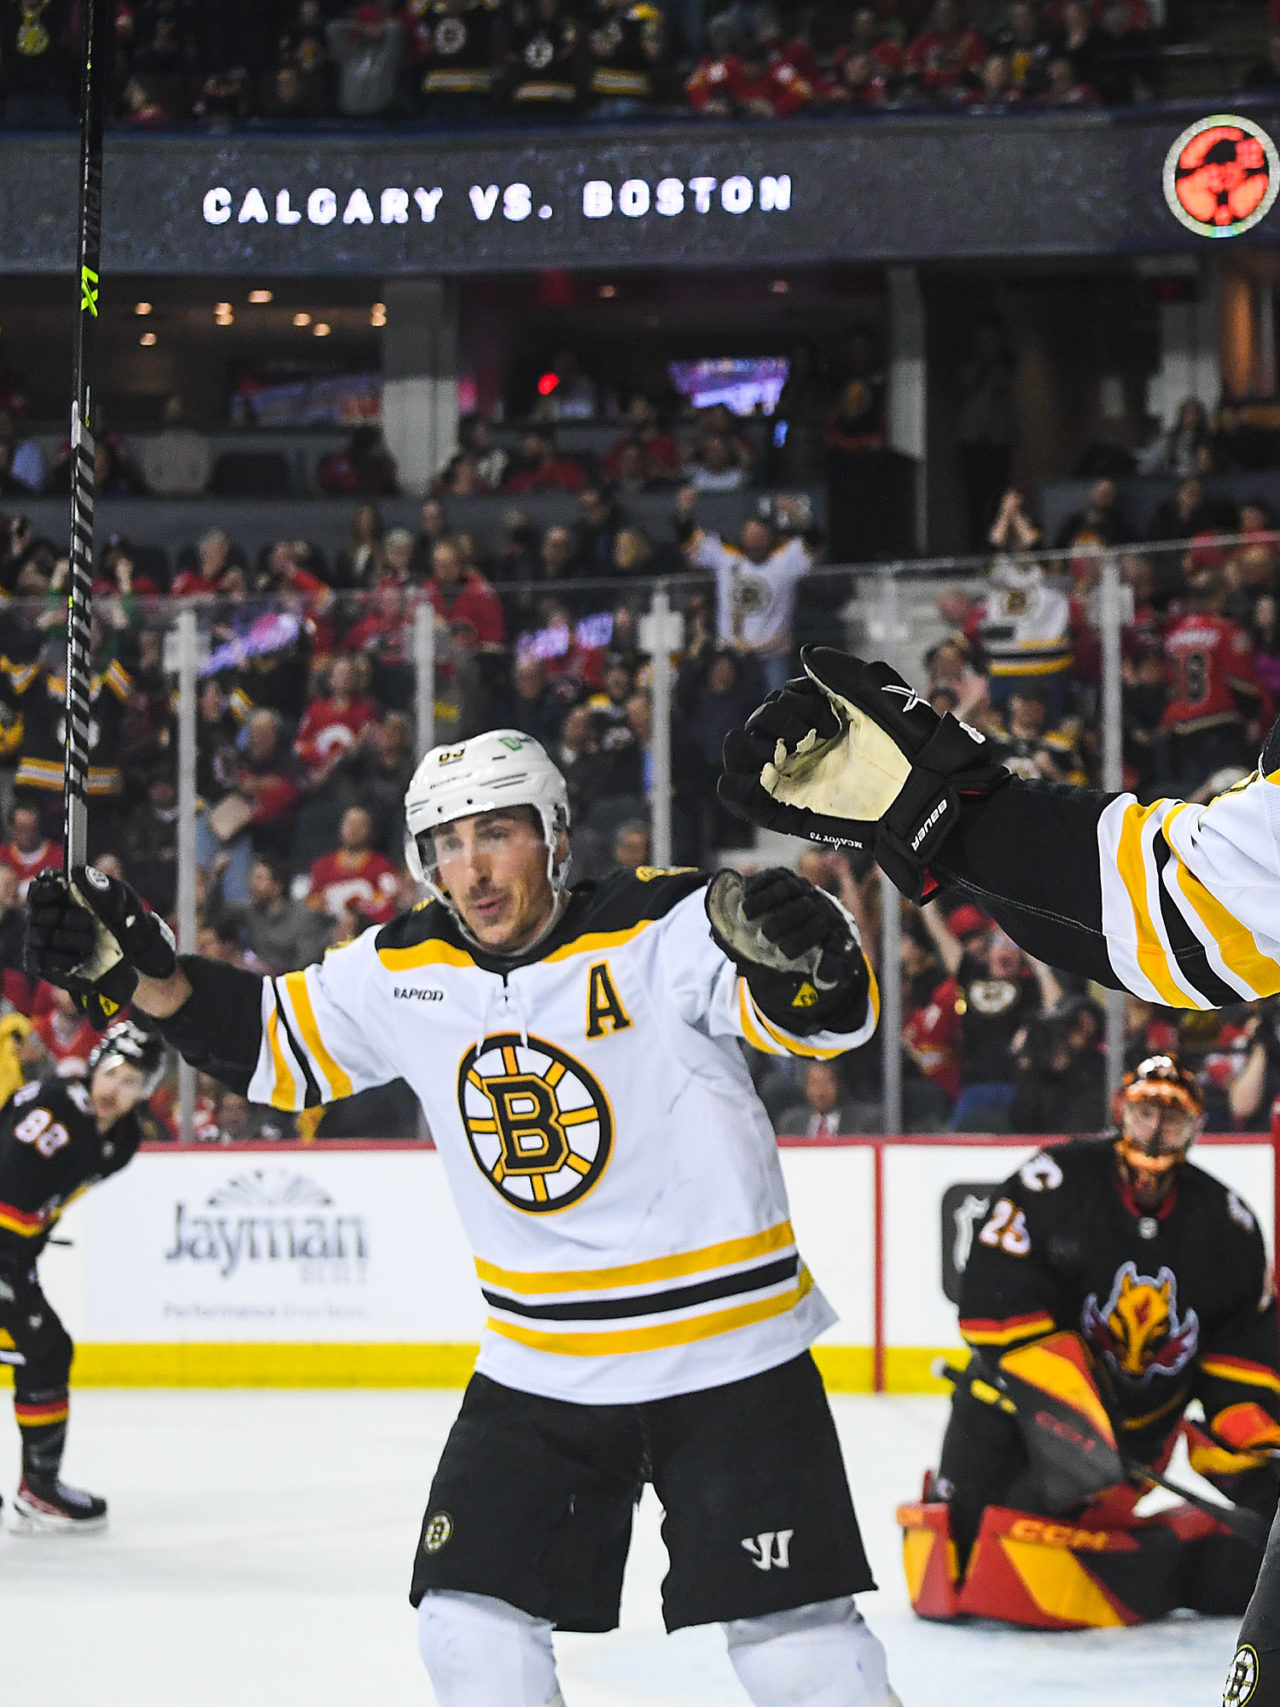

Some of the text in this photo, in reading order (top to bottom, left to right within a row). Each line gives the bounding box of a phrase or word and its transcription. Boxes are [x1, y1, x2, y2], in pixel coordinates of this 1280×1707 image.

[203, 174, 792, 225] CALGARY VS. BOSTON
[911, 799, 947, 851] BAUER
[584, 960, 635, 1041] A
[14, 1107, 70, 1158] 88
[480, 1072, 571, 1178] B
[165, 1202, 368, 1277] Jayman
